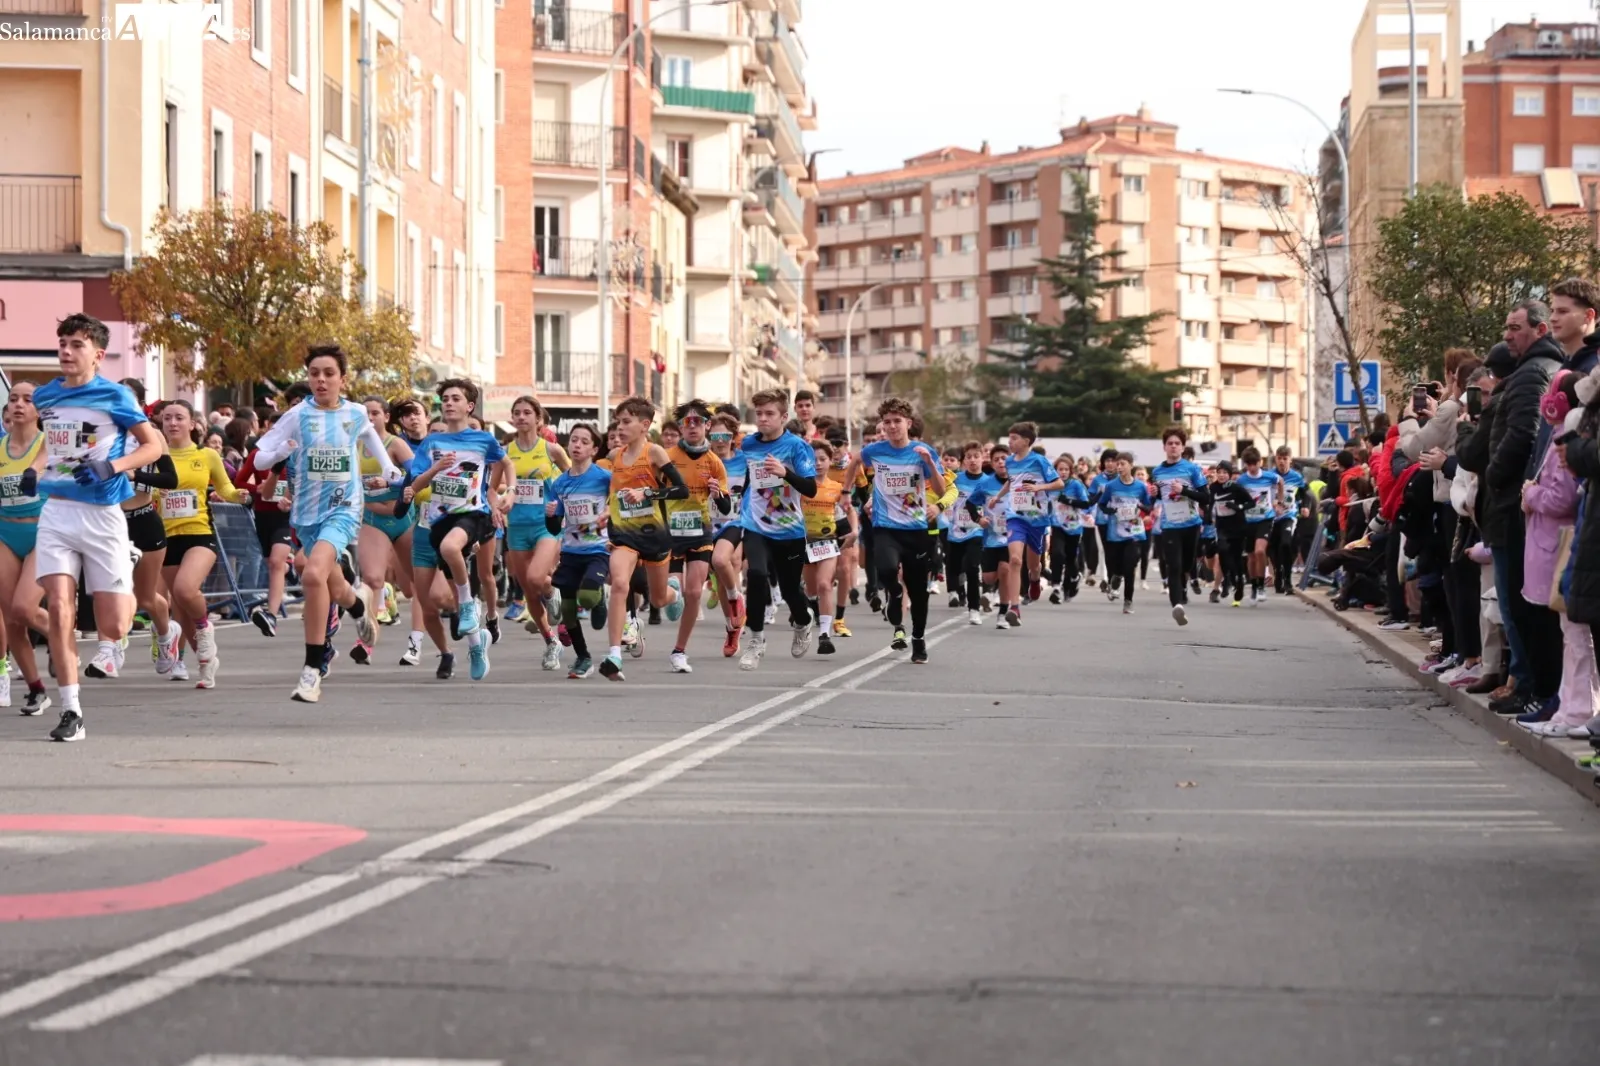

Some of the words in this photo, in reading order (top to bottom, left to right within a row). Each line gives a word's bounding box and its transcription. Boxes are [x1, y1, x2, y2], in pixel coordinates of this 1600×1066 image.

[48, 431, 69, 445] 6148
[312, 457, 342, 471] 6295
[435, 481, 459, 496] 6332
[886, 477, 908, 488] 6328
[165, 497, 187, 510] 6189
[134, 504, 154, 518] PRO
[568, 504, 589, 517] 6323
[675, 518, 695, 529] 6123
